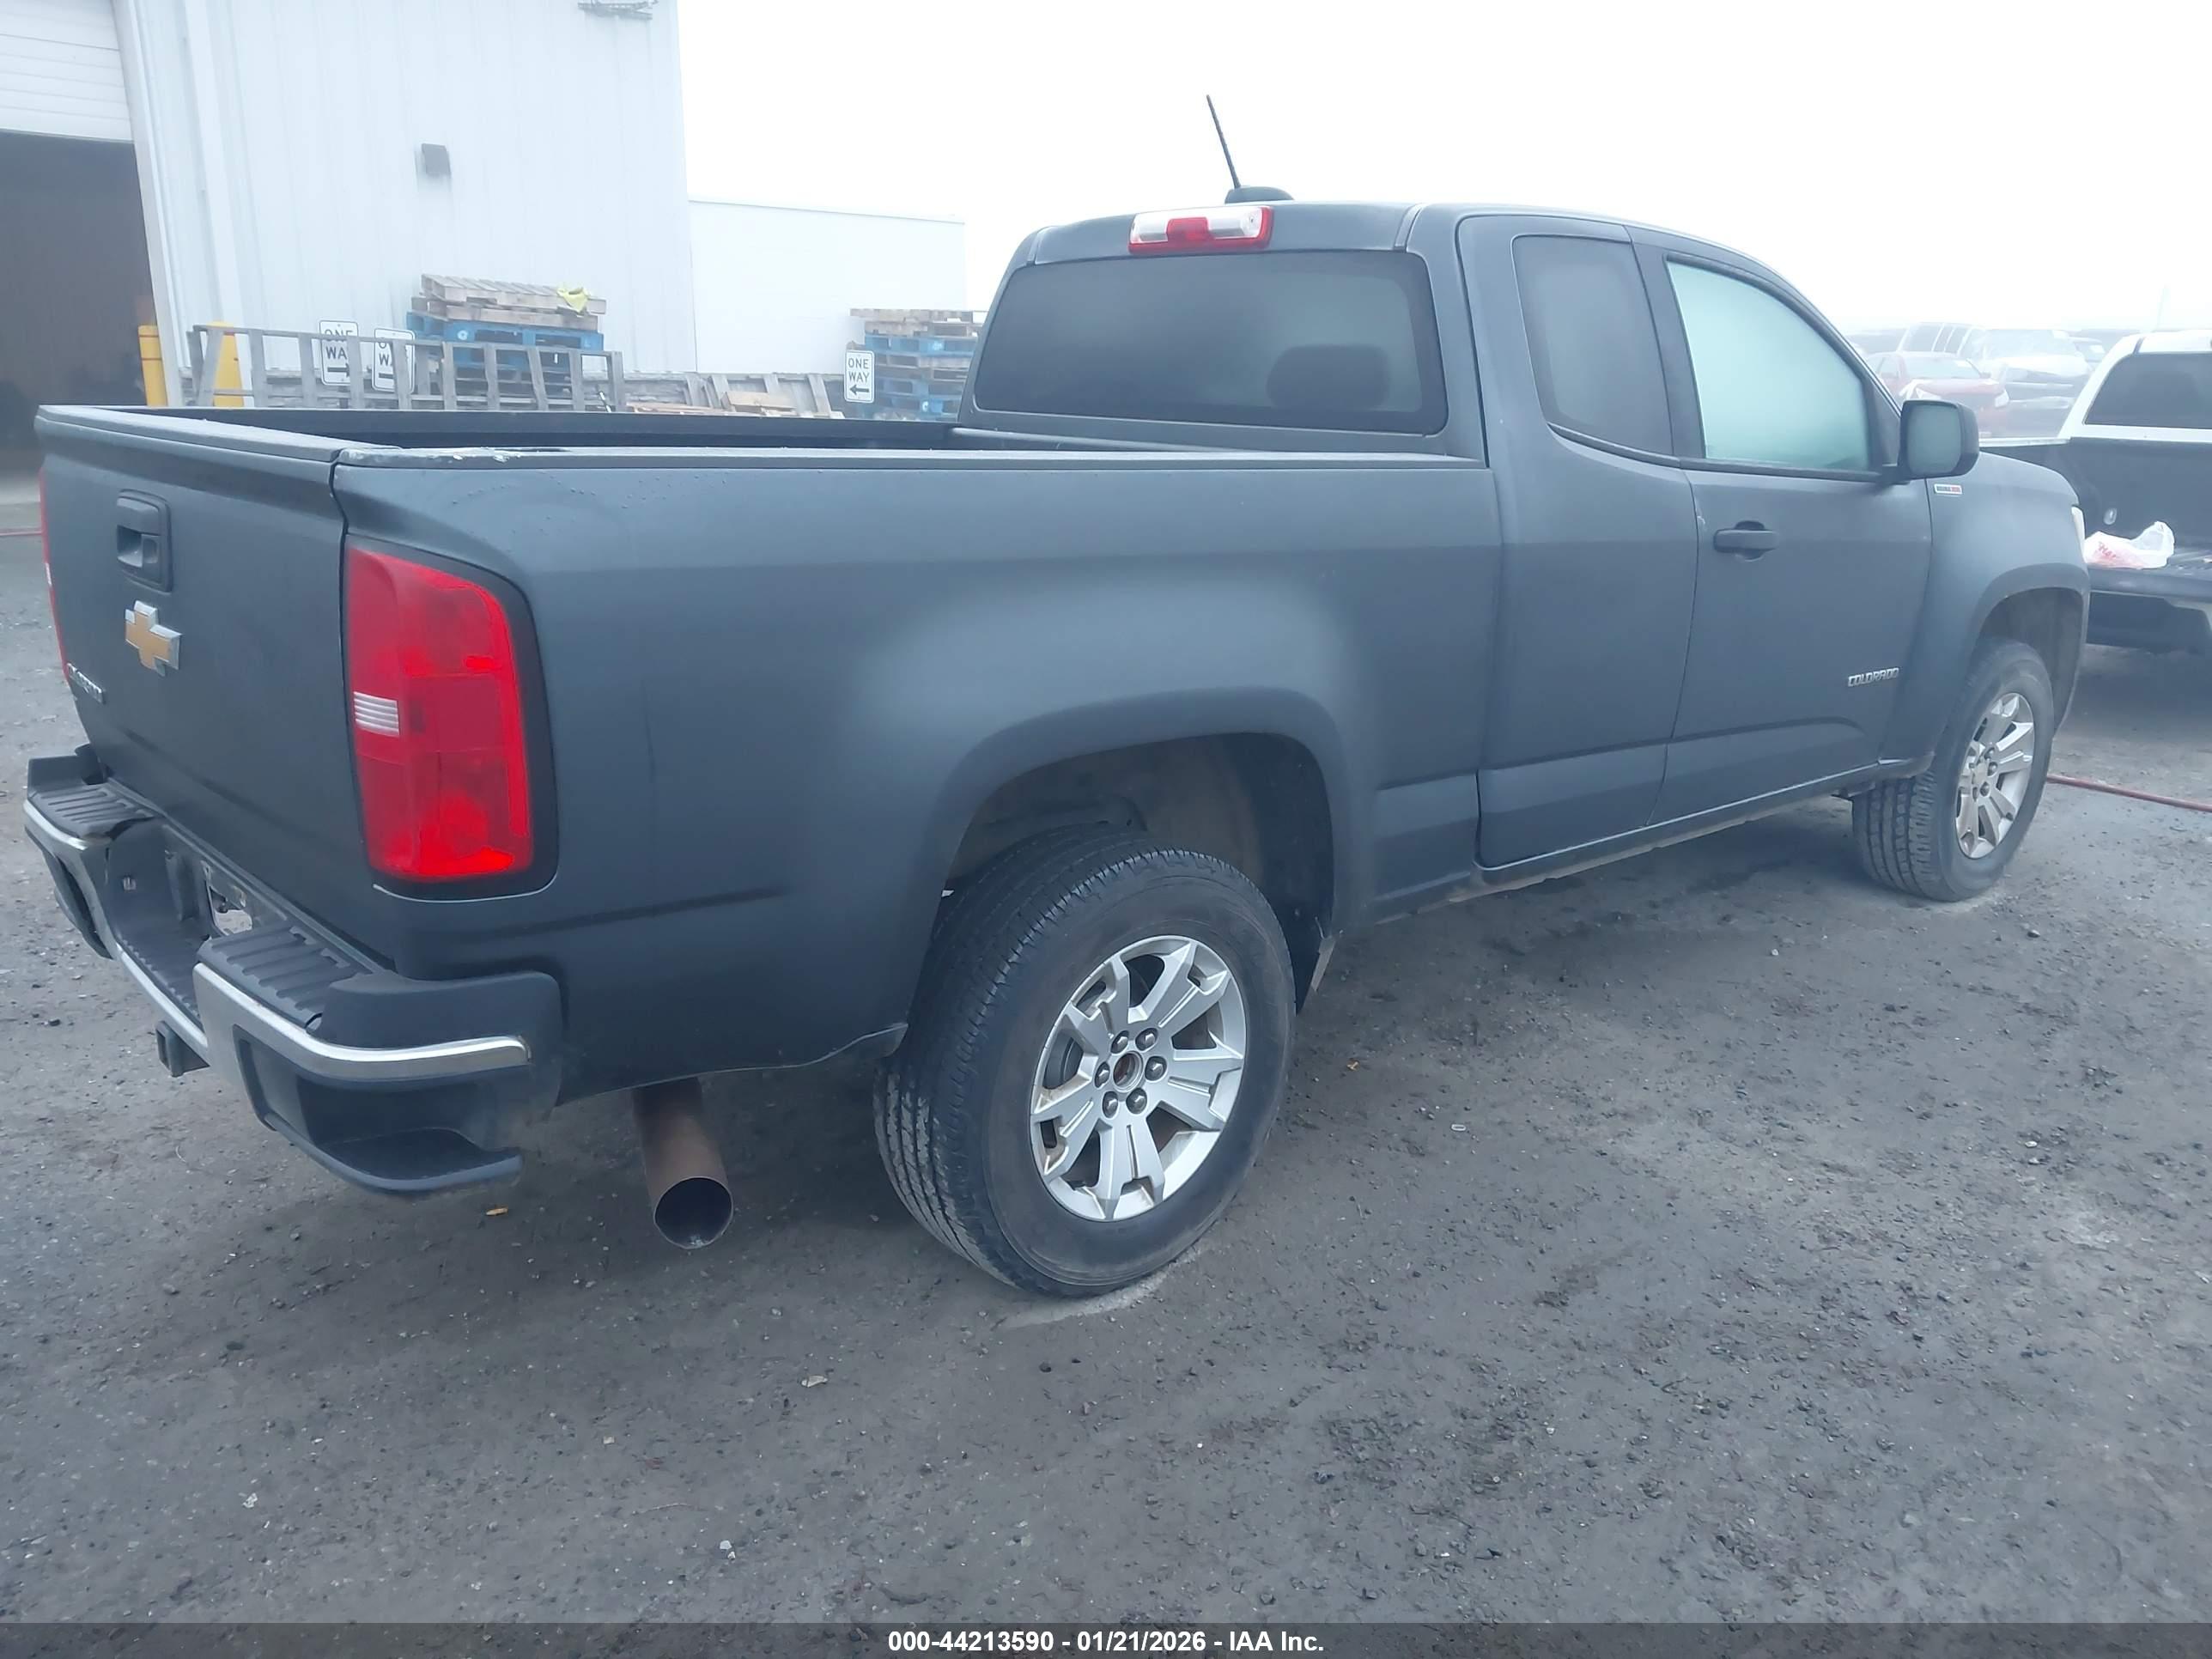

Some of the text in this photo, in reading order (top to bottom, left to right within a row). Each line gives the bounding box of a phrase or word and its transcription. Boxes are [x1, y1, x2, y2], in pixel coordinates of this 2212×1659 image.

[326, 346, 348, 360] WA
[848, 357, 869, 369] ONE
[848, 371, 870, 383] WAY
[1848, 667, 1899, 687] COLORADO
